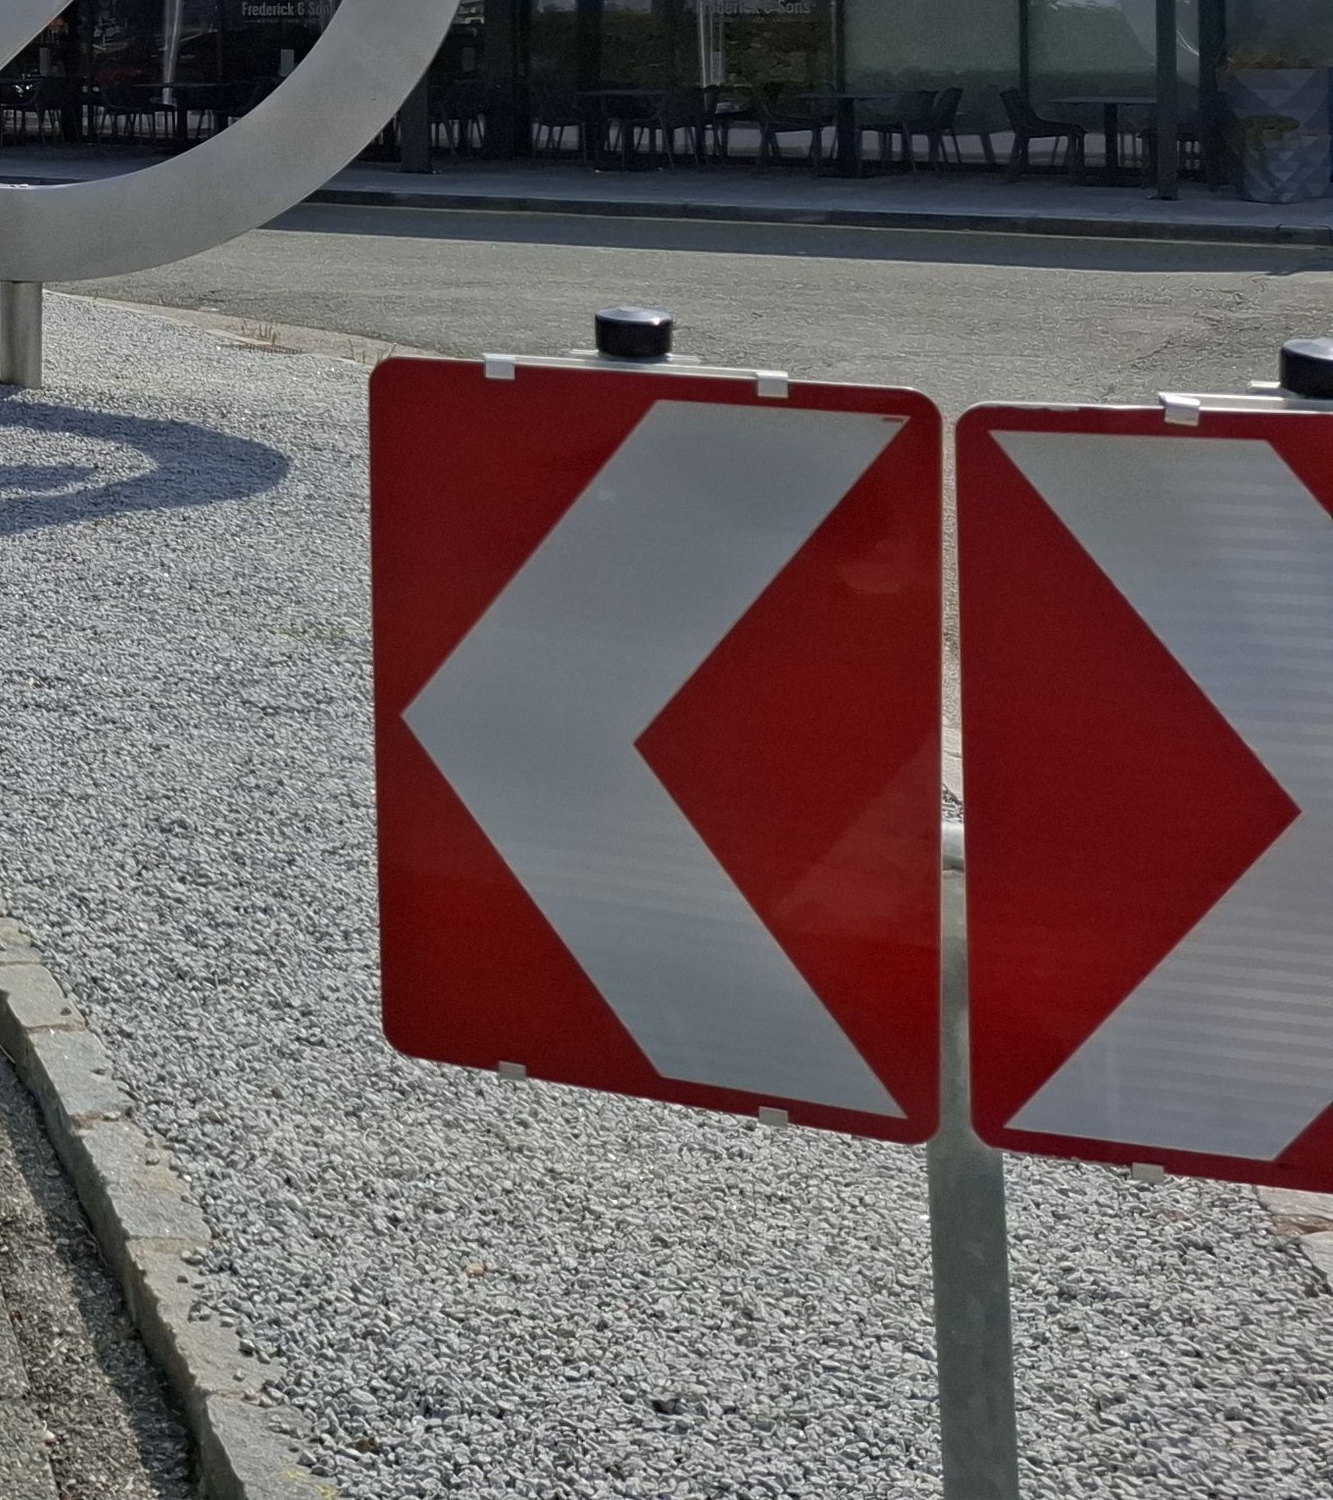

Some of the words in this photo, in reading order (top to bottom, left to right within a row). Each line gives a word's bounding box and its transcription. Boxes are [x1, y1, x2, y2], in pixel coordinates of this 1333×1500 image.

[242, 2, 294, 16] Frederick
[308, 2, 331, 15] Son
[777, 0, 811, 14] Sons
